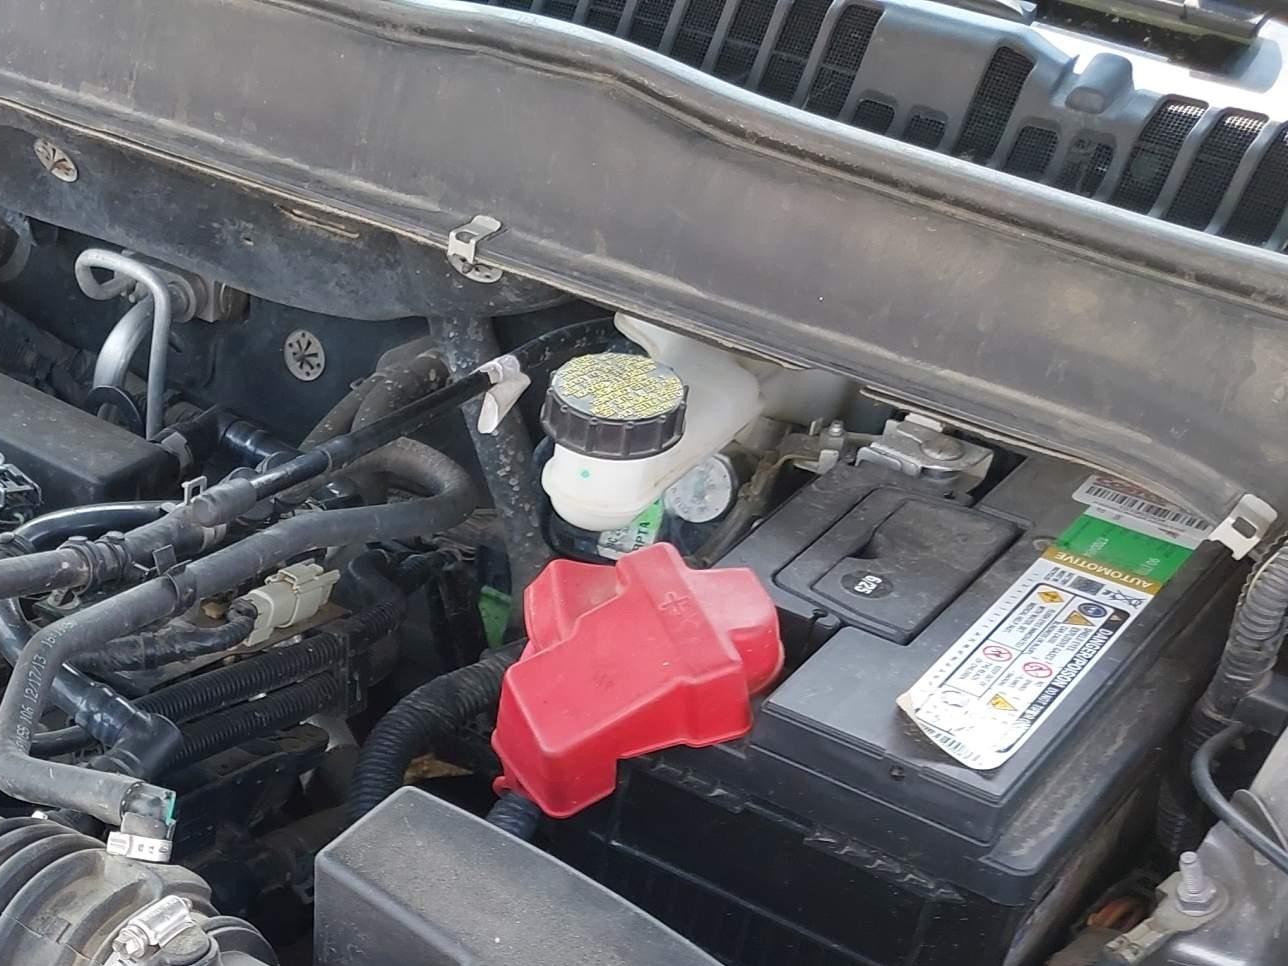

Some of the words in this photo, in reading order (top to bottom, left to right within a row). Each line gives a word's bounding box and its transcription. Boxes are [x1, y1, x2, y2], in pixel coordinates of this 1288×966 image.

[854, 575, 882, 594] 6/25
[1054, 551, 1154, 589] AUTOMOTIVE
[1050, 626, 1114, 689] DANGER/POISON
[24, 656, 47, 702] 12/17/13
